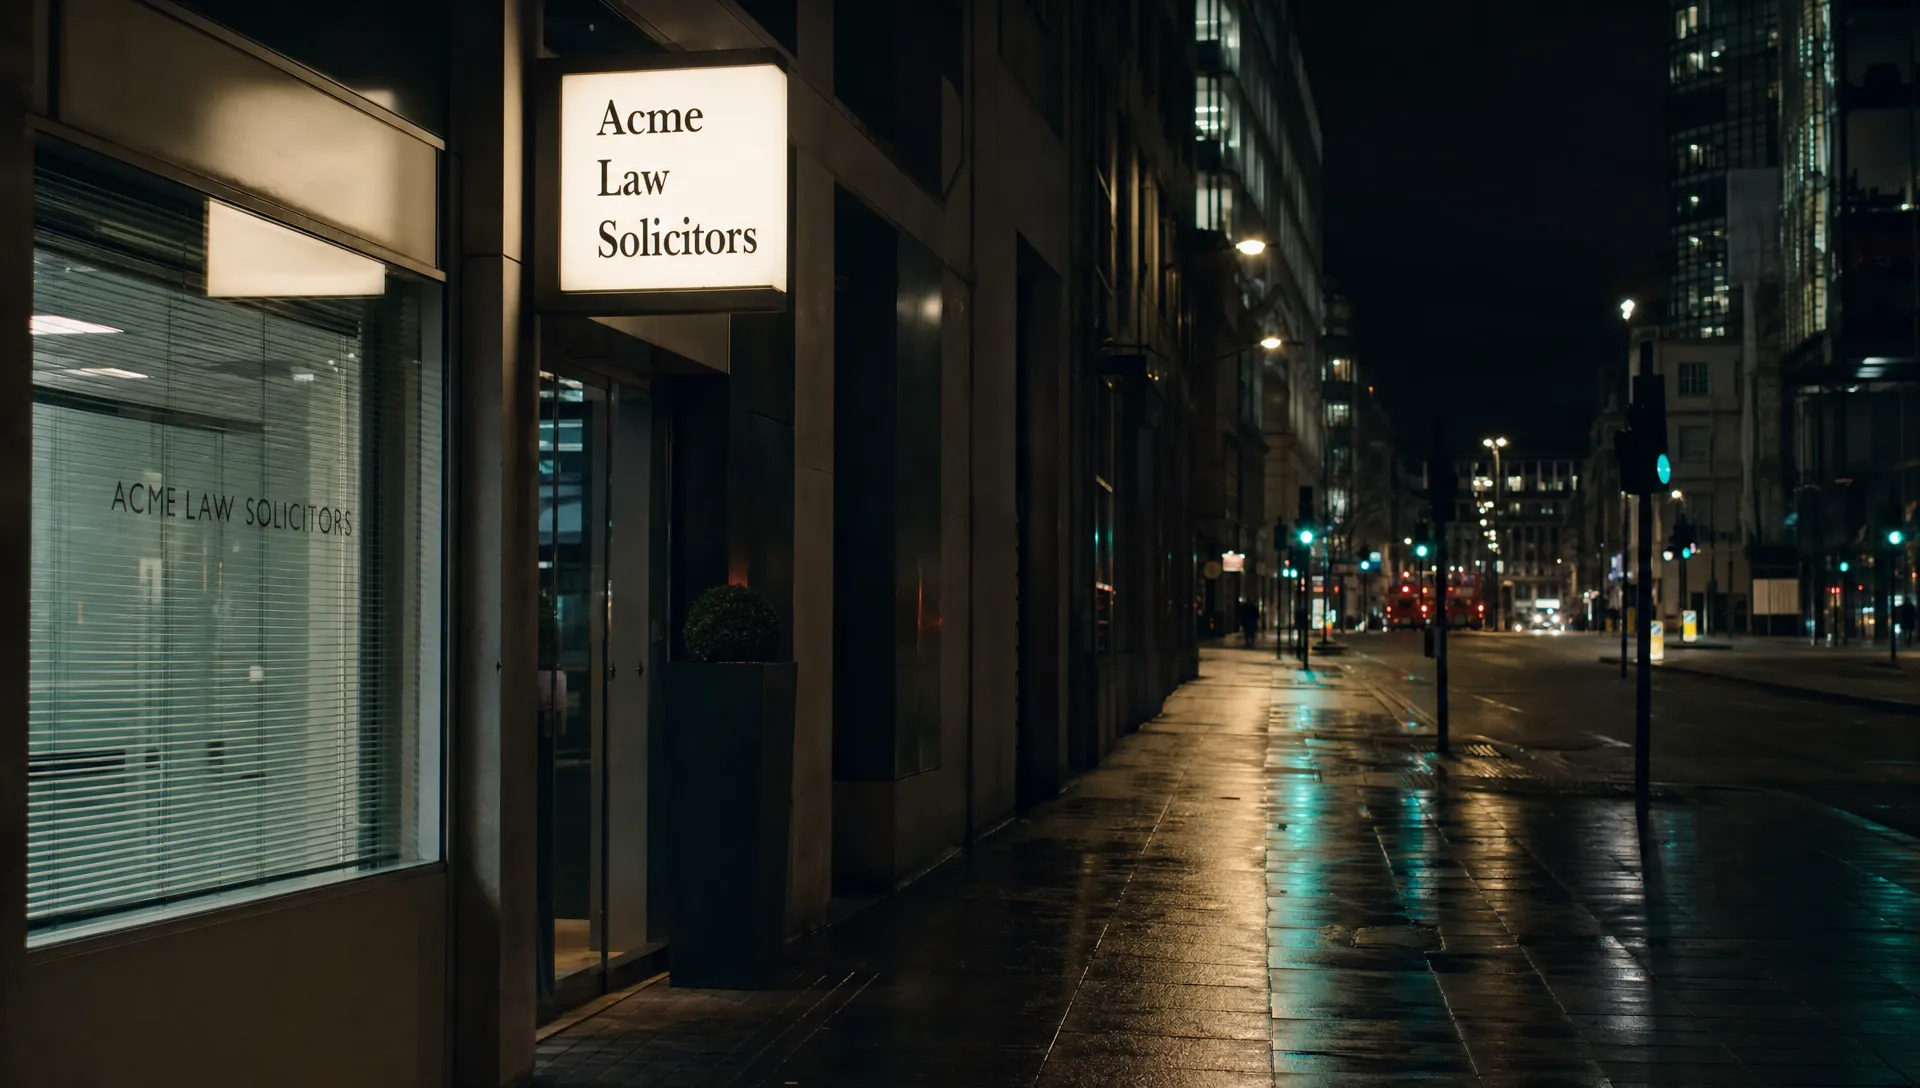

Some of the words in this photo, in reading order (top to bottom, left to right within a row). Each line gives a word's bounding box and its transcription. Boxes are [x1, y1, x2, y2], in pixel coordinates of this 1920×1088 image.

[596, 99, 704, 136] Acme
[597, 159, 670, 197] Law
[598, 216, 757, 259] Solicitors
[111, 480, 176, 517] ACME
[186, 490, 235, 522] LAW
[245, 497, 353, 536] SOLICITORS
